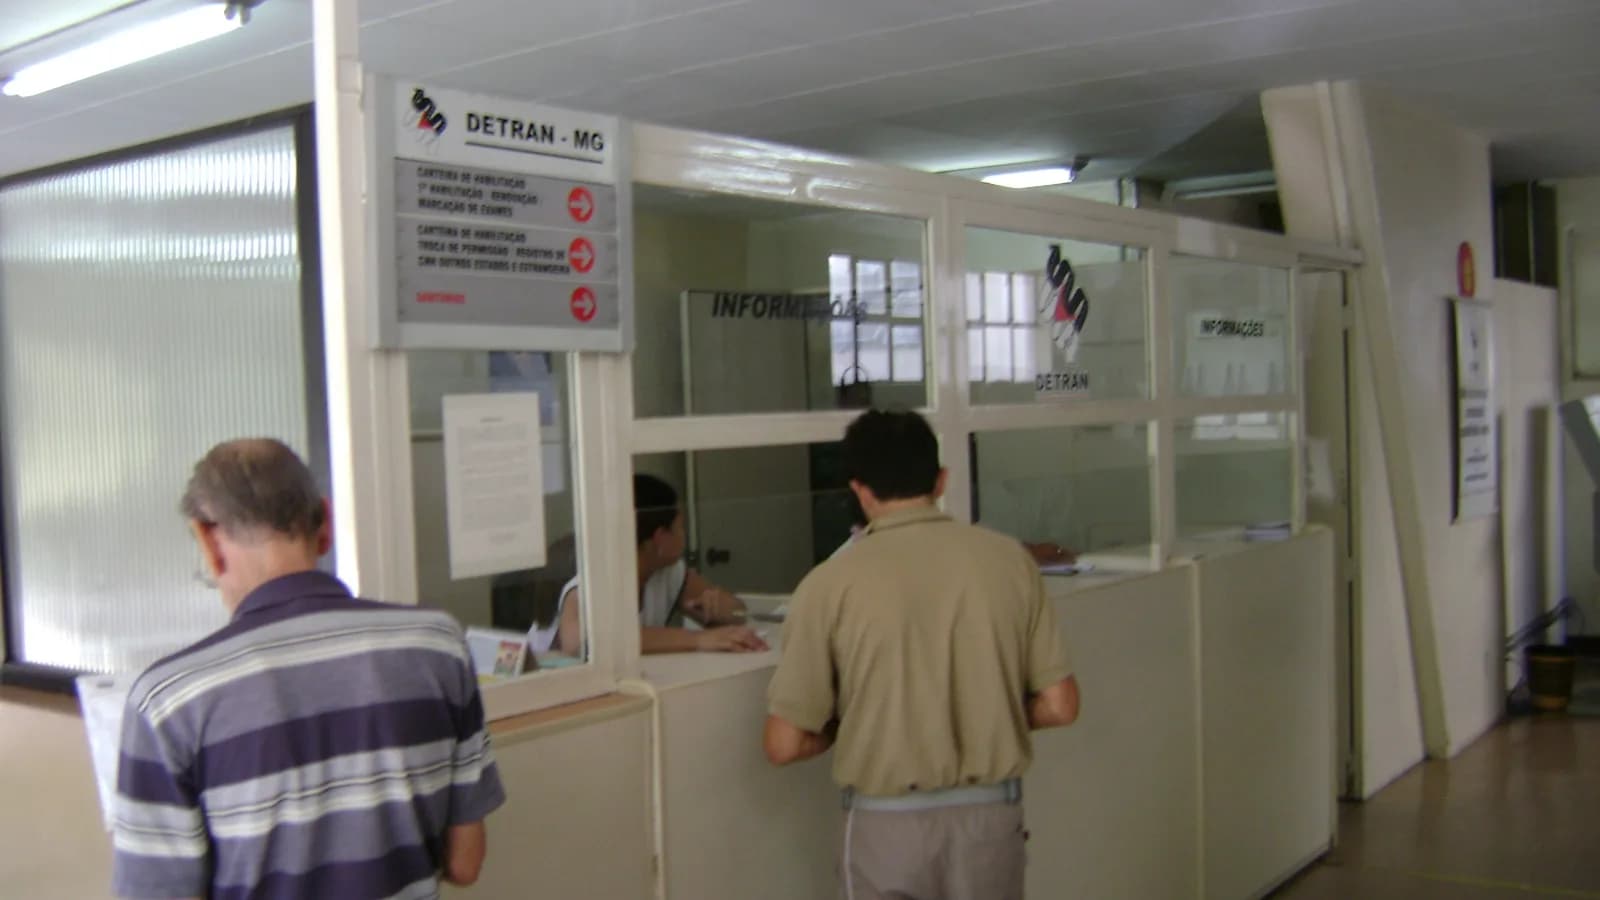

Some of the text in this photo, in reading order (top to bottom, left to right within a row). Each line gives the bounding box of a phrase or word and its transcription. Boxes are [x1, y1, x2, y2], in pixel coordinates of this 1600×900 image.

[466, 112, 555, 145] DETRAN
[573, 130, 605, 151] MG
[461, 172, 471, 183] DE
[467, 203, 478, 214] DE
[461, 228, 471, 239] DE
[448, 243, 459, 253] DE
[711, 292, 868, 320] INFORMÕES
[1199, 320, 1264, 338] INFORMAÇÕES
[1035, 374, 1089, 391] DETRAN
